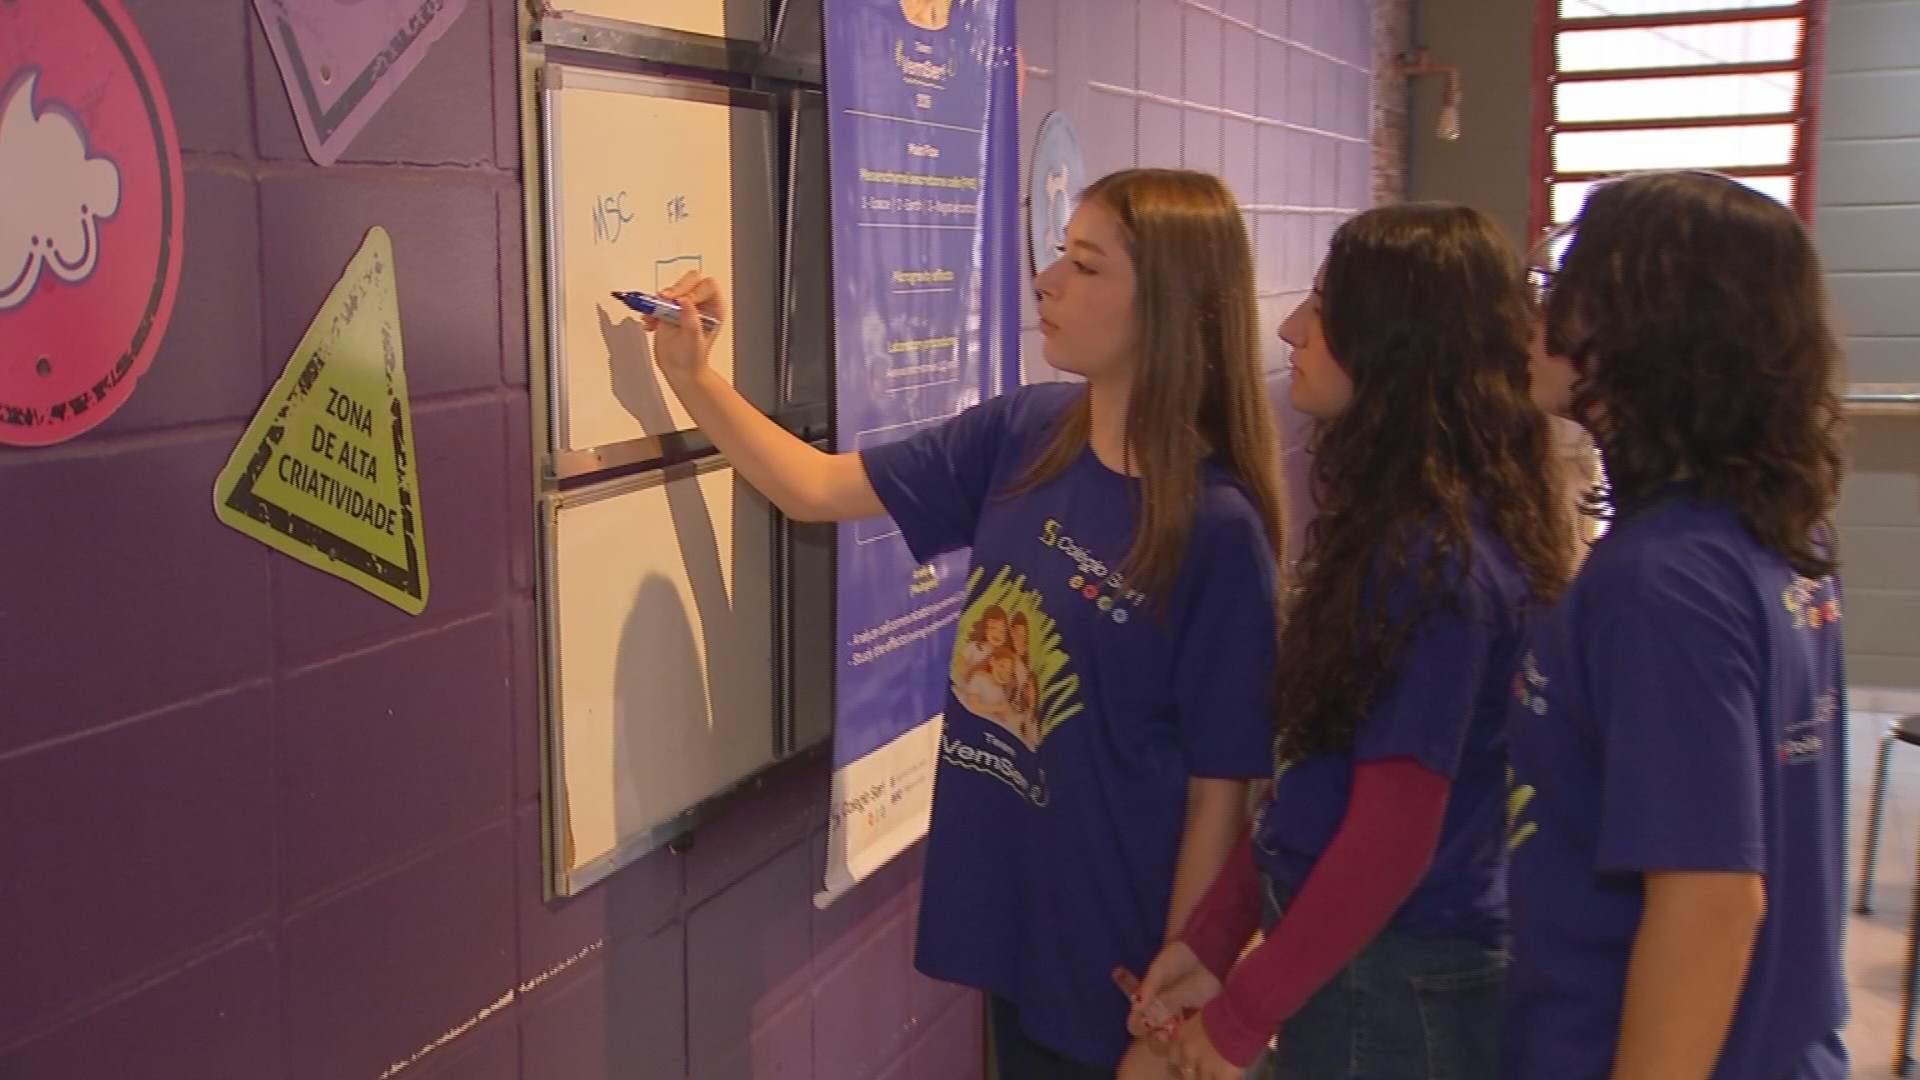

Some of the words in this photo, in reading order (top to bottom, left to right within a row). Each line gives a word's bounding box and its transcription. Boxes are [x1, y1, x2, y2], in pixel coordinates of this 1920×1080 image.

[592, 190, 634, 245] MSC
[326, 387, 372, 437] ZONA
[311, 424, 337, 460] DE
[338, 441, 377, 484] ALTA
[278, 454, 398, 536] CRIATIVIDADE
